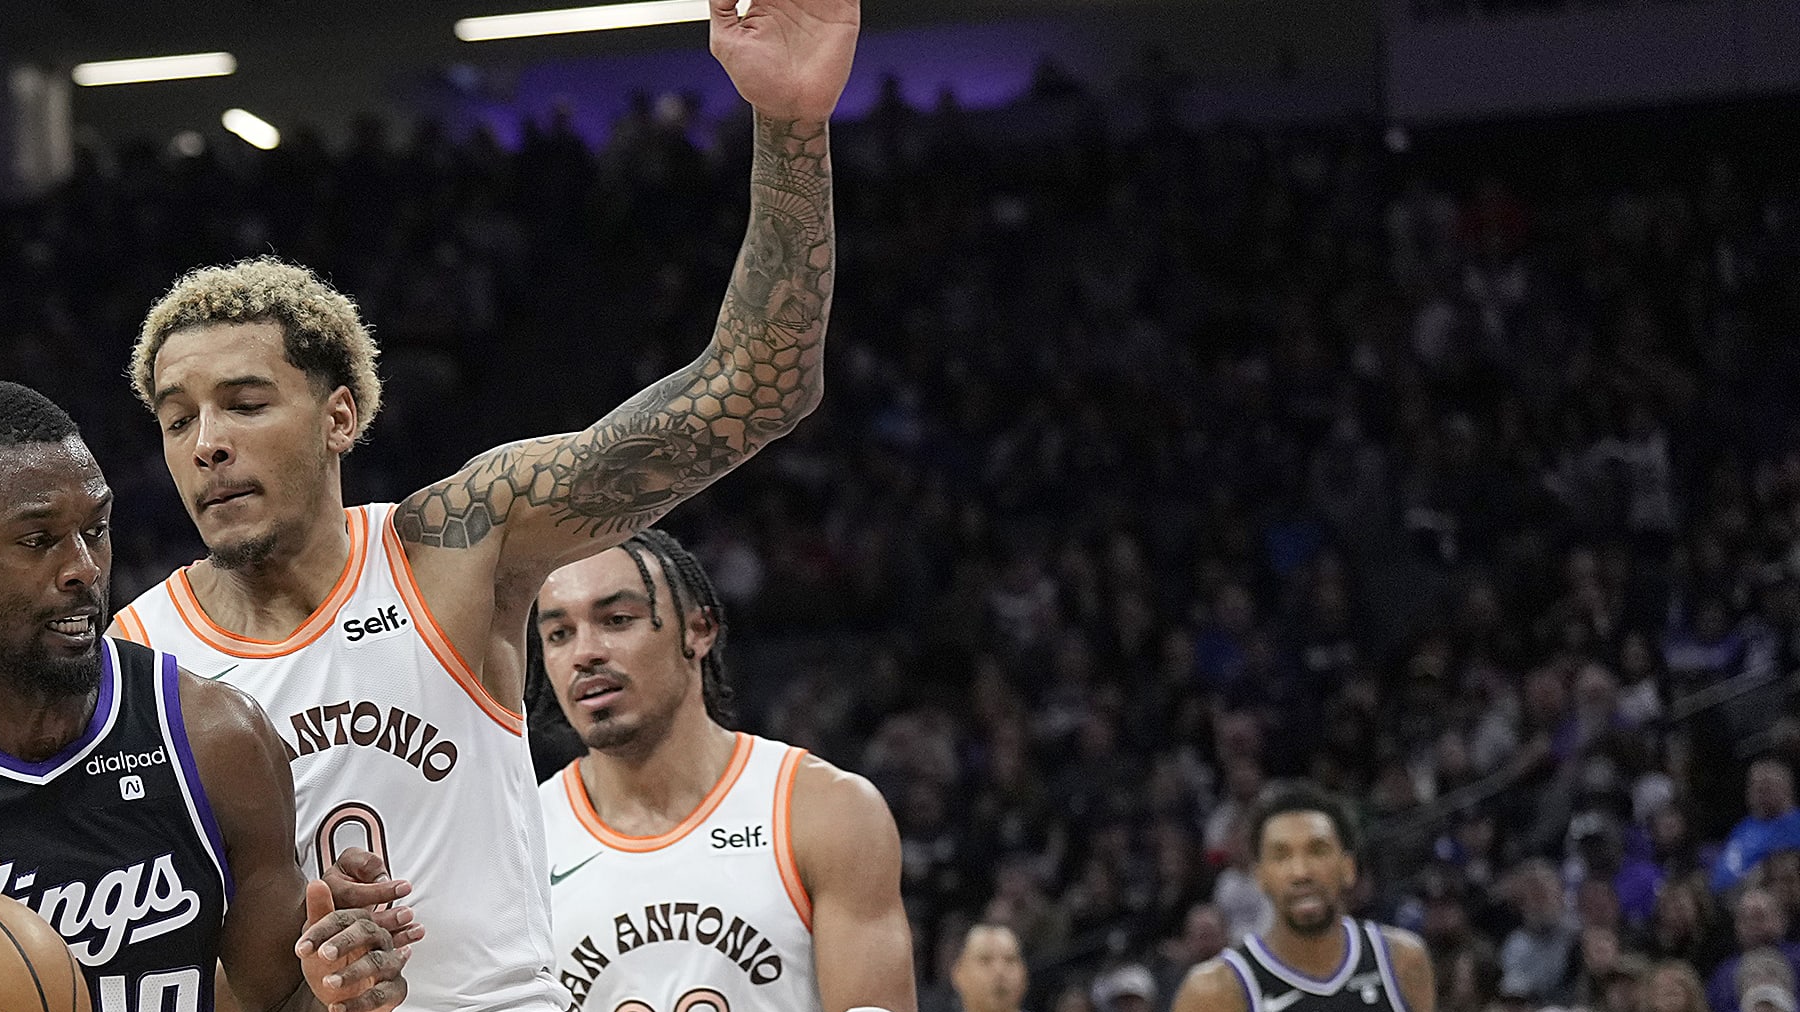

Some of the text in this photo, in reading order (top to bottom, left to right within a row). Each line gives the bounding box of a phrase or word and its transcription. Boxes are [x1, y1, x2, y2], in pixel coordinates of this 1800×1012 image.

[343, 604, 408, 642] Self.
[281, 700, 458, 782] NTONIO
[85, 745, 167, 776] dialpad
[710, 825, 767, 849] Self.
[613, 902, 782, 985] ANTONIO
